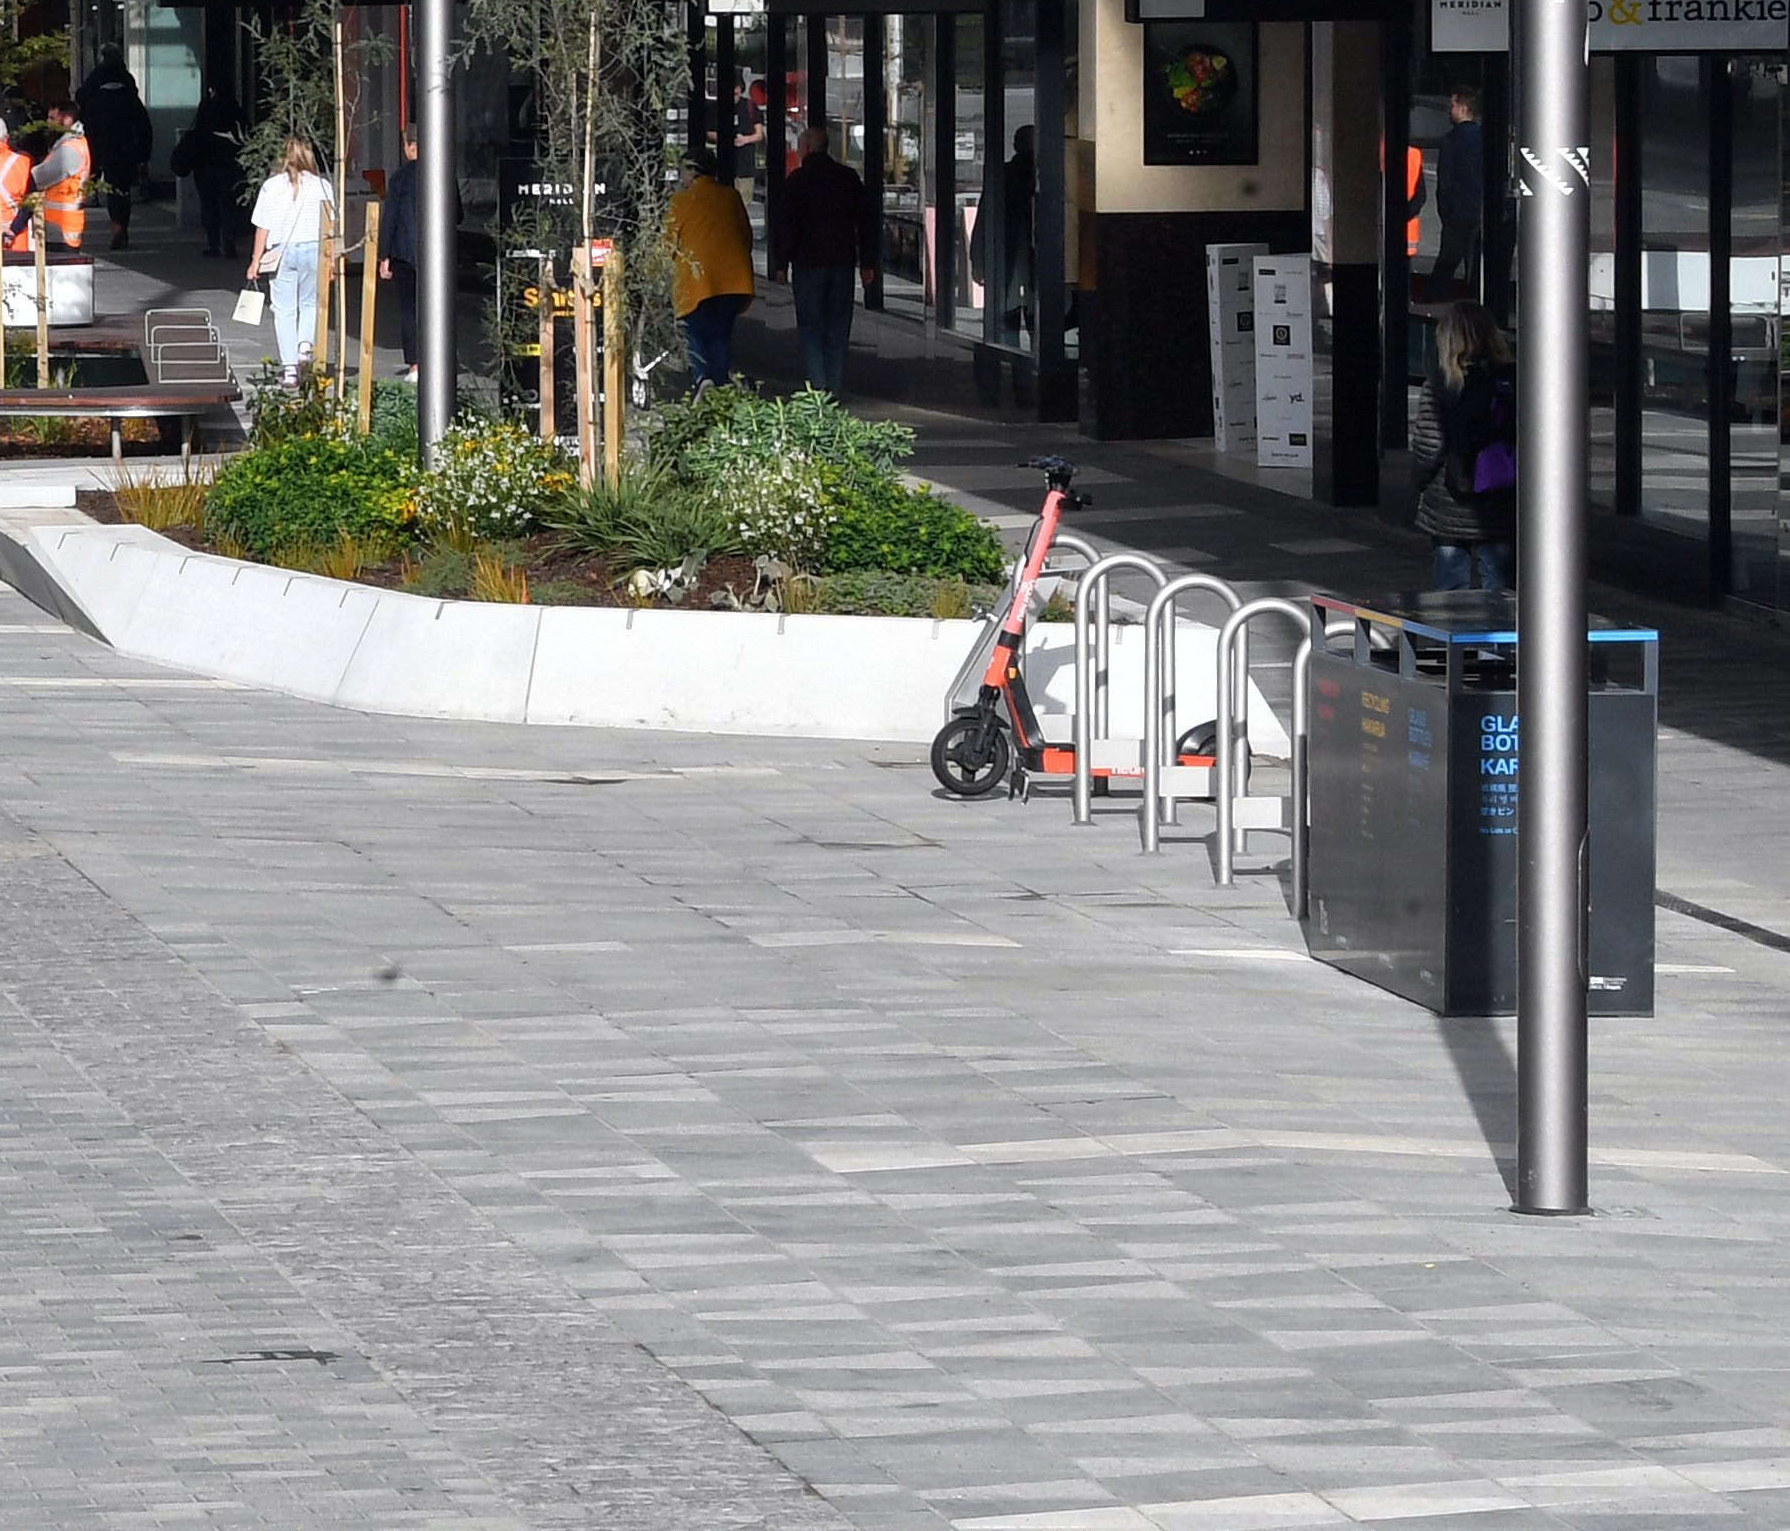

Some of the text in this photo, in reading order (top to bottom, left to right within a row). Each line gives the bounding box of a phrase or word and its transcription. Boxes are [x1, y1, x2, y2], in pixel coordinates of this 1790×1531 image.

[1439, 0, 1502, 9] MERIDIAN
[518, 182, 606, 196] MERIDN
[1480, 715, 1519, 733] GLA
